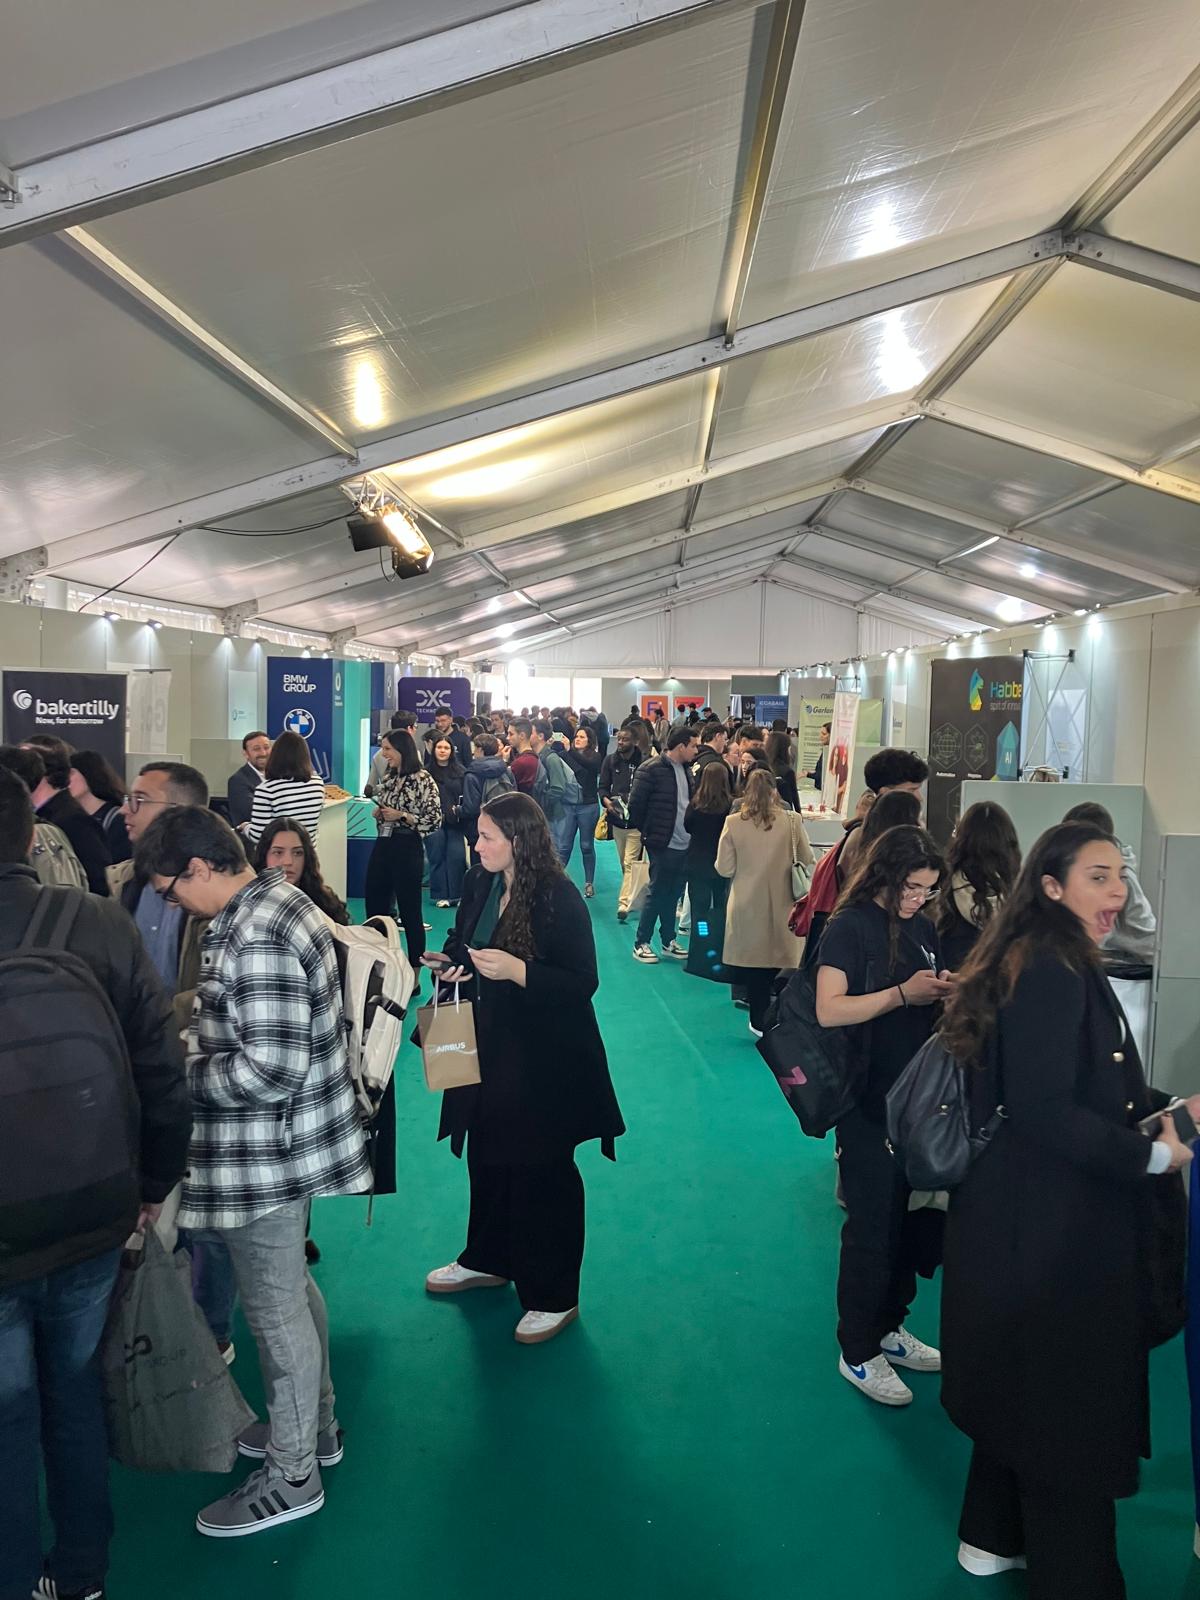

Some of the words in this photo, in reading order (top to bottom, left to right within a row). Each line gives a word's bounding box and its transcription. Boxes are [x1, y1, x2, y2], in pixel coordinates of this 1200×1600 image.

[283, 674, 308, 683] BMW
[283, 683, 316, 692] GROUP
[36, 699, 119, 719] bakertilly
[1005, 751, 1012, 765] AI
[436, 1042, 466, 1053] AIRBUS
